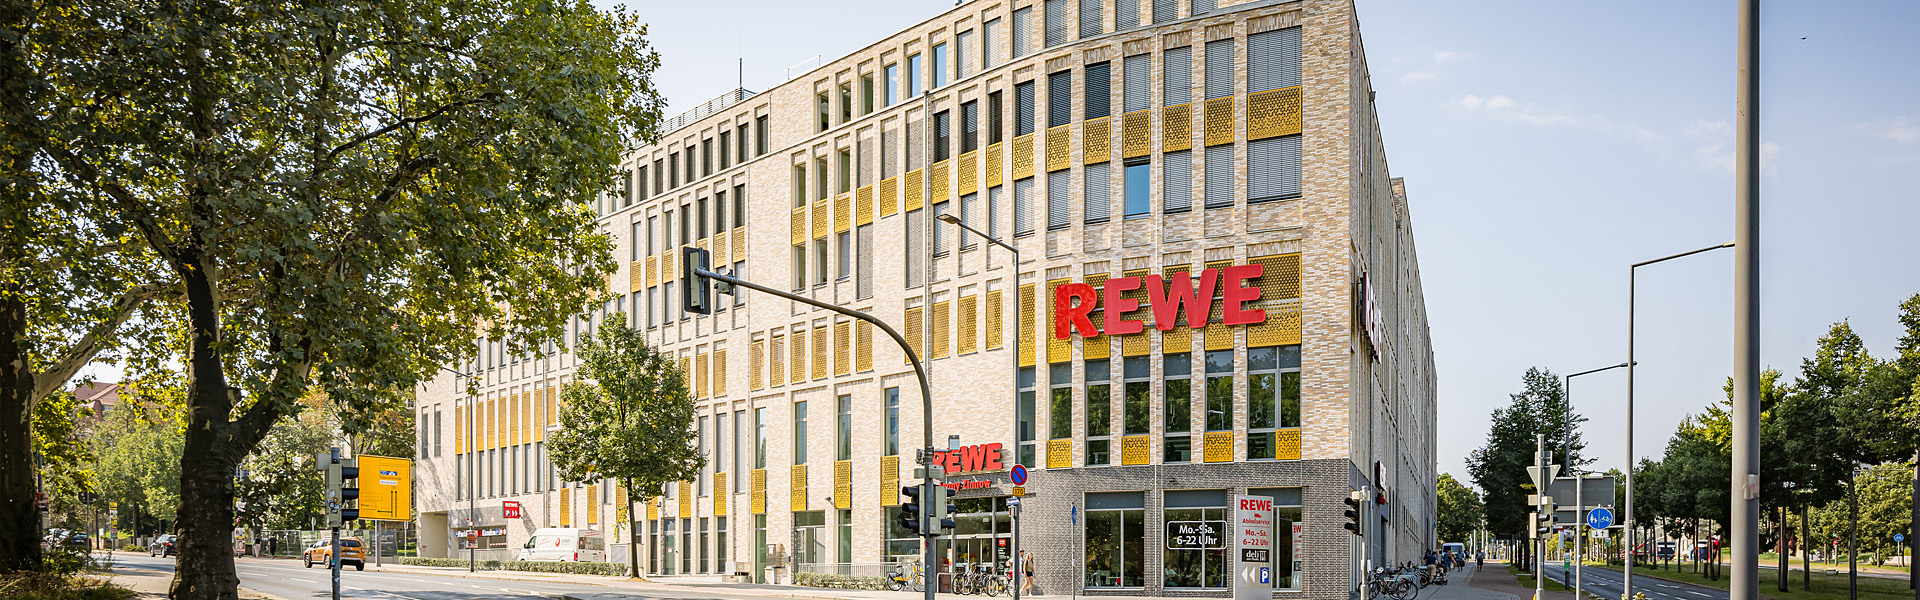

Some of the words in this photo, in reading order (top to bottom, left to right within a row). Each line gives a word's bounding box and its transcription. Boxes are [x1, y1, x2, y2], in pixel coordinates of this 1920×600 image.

[1055, 263, 1266, 340] REWE
[932, 442, 1003, 474] REWE
[962, 479, 991, 489] Zinnow
[1240, 499, 1272, 511] REWE
[1179, 525, 1216, 534] Mo.-Sa.
[1245, 528, 1268, 537] Mo.-Sa.
[1177, 535, 1197, 545] 6-22
[1198, 535, 1218, 545] Uhr
[1242, 538, 1259, 546] 6-22
[1259, 538, 1270, 546] Uhr
[1246, 550, 1260, 558] deli
[1261, 570, 1268, 583] P
